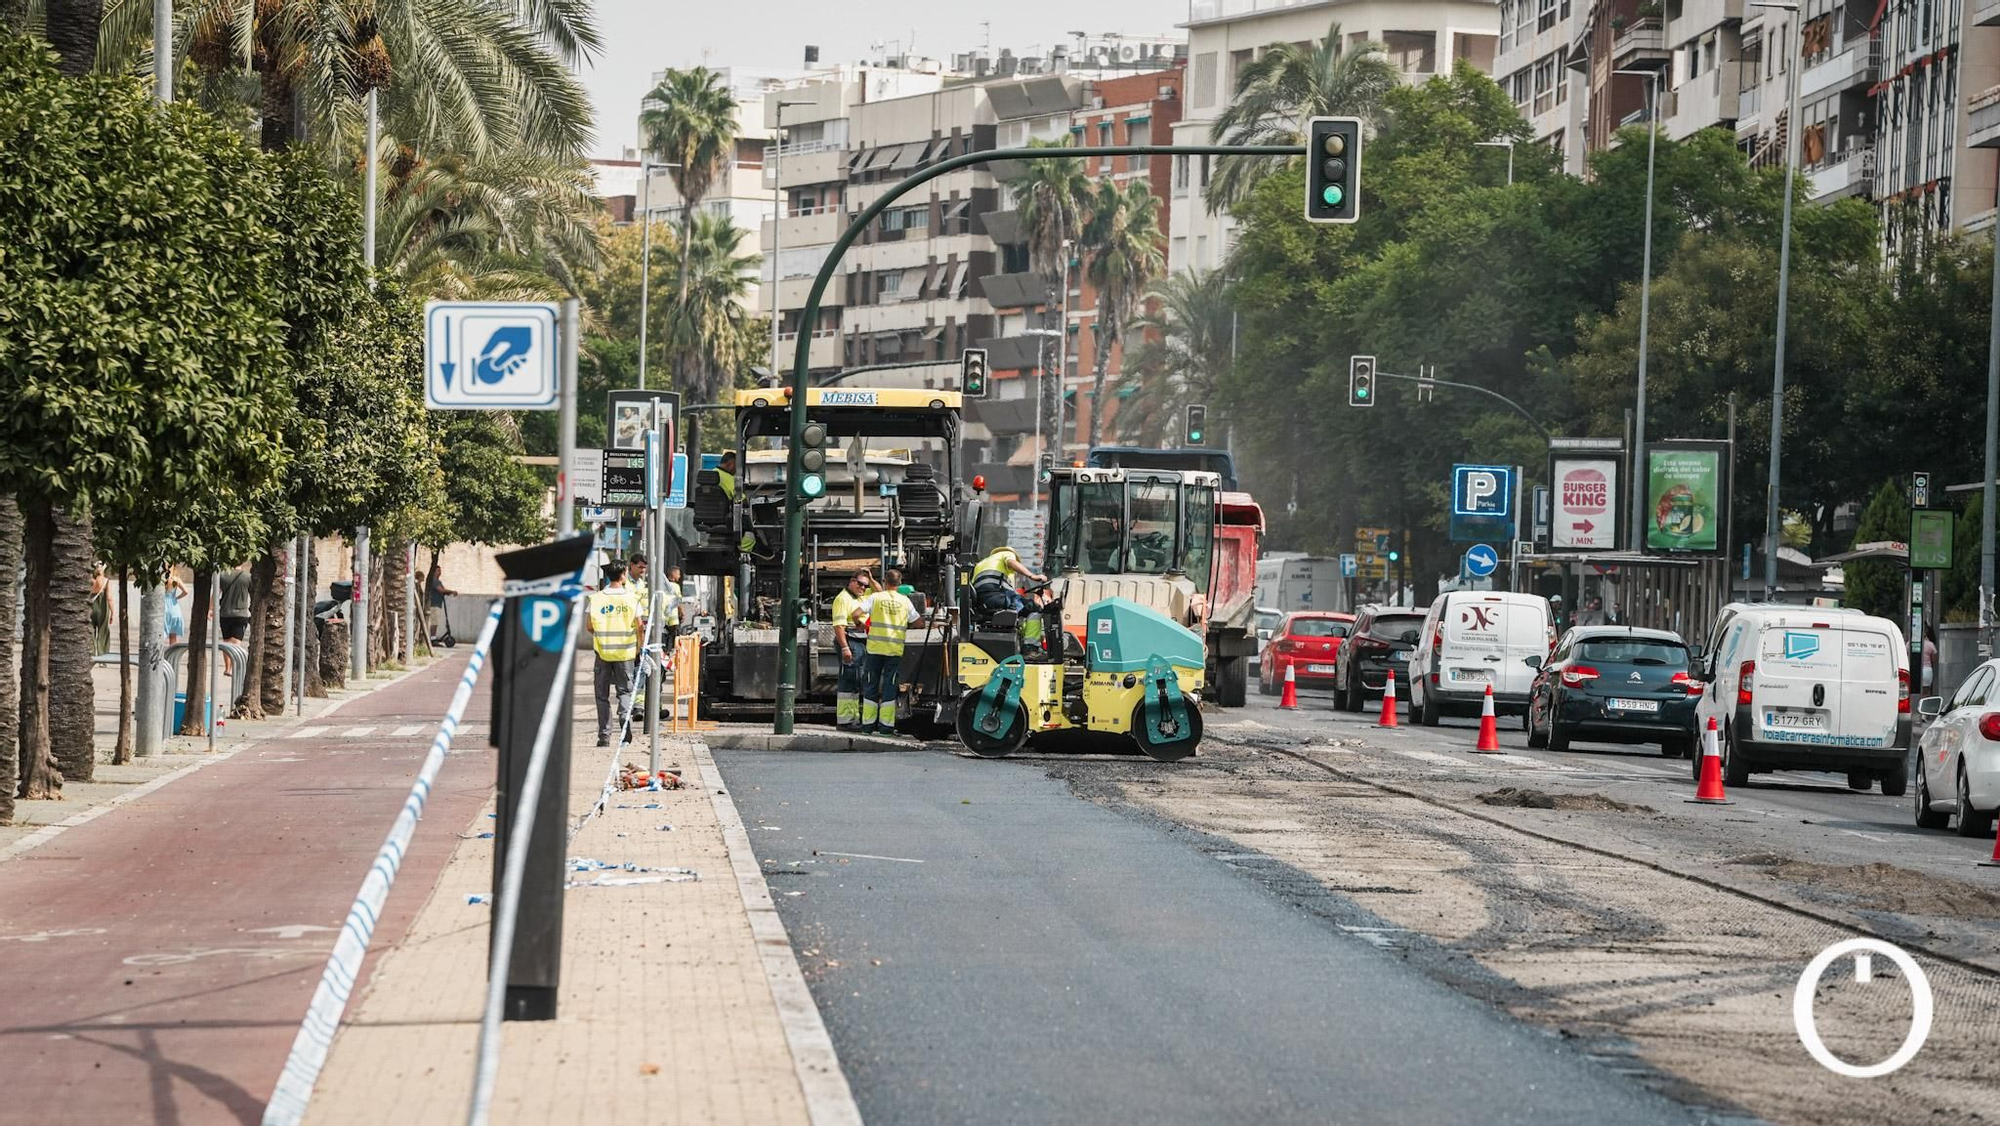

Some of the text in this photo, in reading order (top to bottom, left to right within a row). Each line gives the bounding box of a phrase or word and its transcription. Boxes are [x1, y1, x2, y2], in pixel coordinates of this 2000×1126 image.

[822, 392, 875, 404] MEBISA
[626, 458, 645, 468] 145
[1467, 472, 1496, 510] P
[1563, 483, 1607, 493] BURGER
[1563, 493, 1607, 507] KING
[532, 600, 560, 642] P
[1617, 701, 1655, 710] 1559 HNG
[1774, 715, 1821, 727] 5177 GRY
